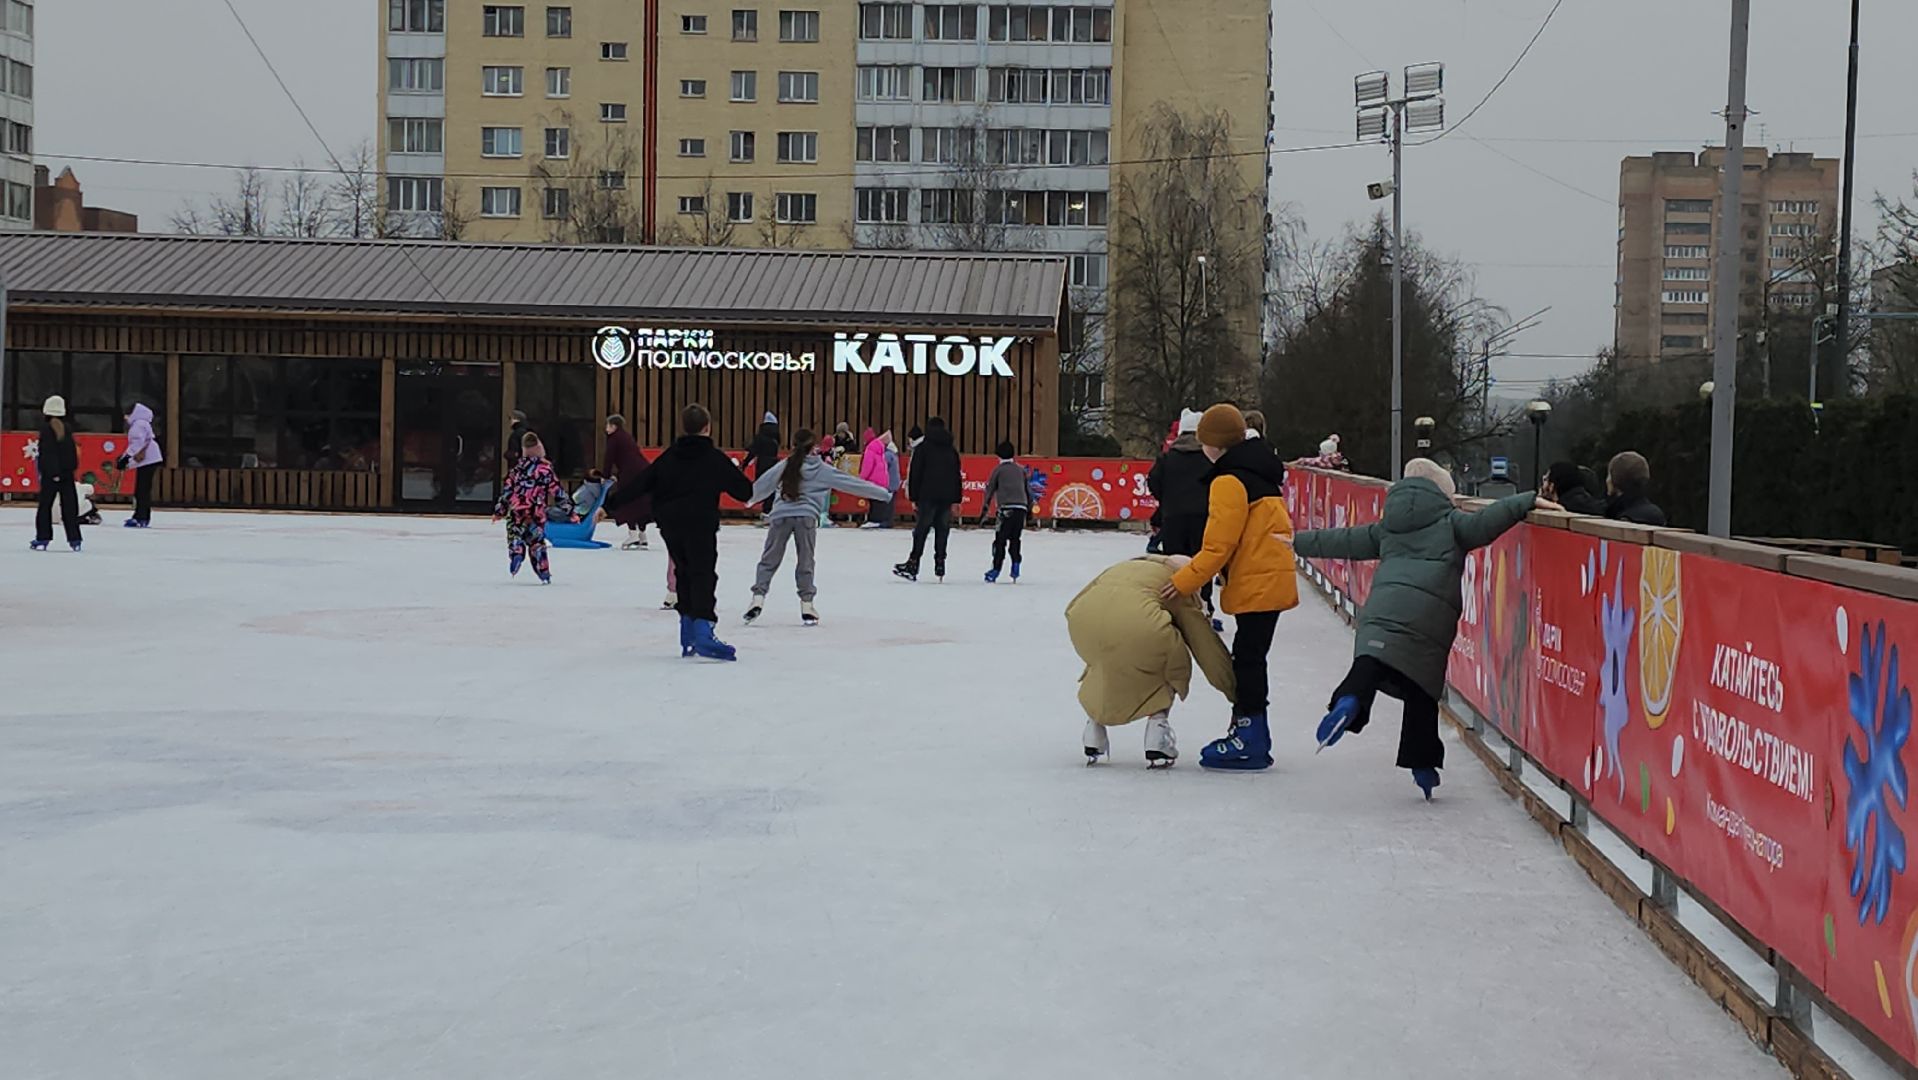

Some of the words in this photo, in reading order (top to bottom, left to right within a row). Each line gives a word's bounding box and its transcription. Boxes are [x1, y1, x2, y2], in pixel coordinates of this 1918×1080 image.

[637, 328, 714, 349] ПАРКИ
[833, 332, 1016, 378] КАТОК
[637, 350, 815, 372] ПОДМОСКОВЬЯ
[1710, 640, 1784, 713] КАТАЙТЕСЬ
[1692, 697, 1700, 739] С
